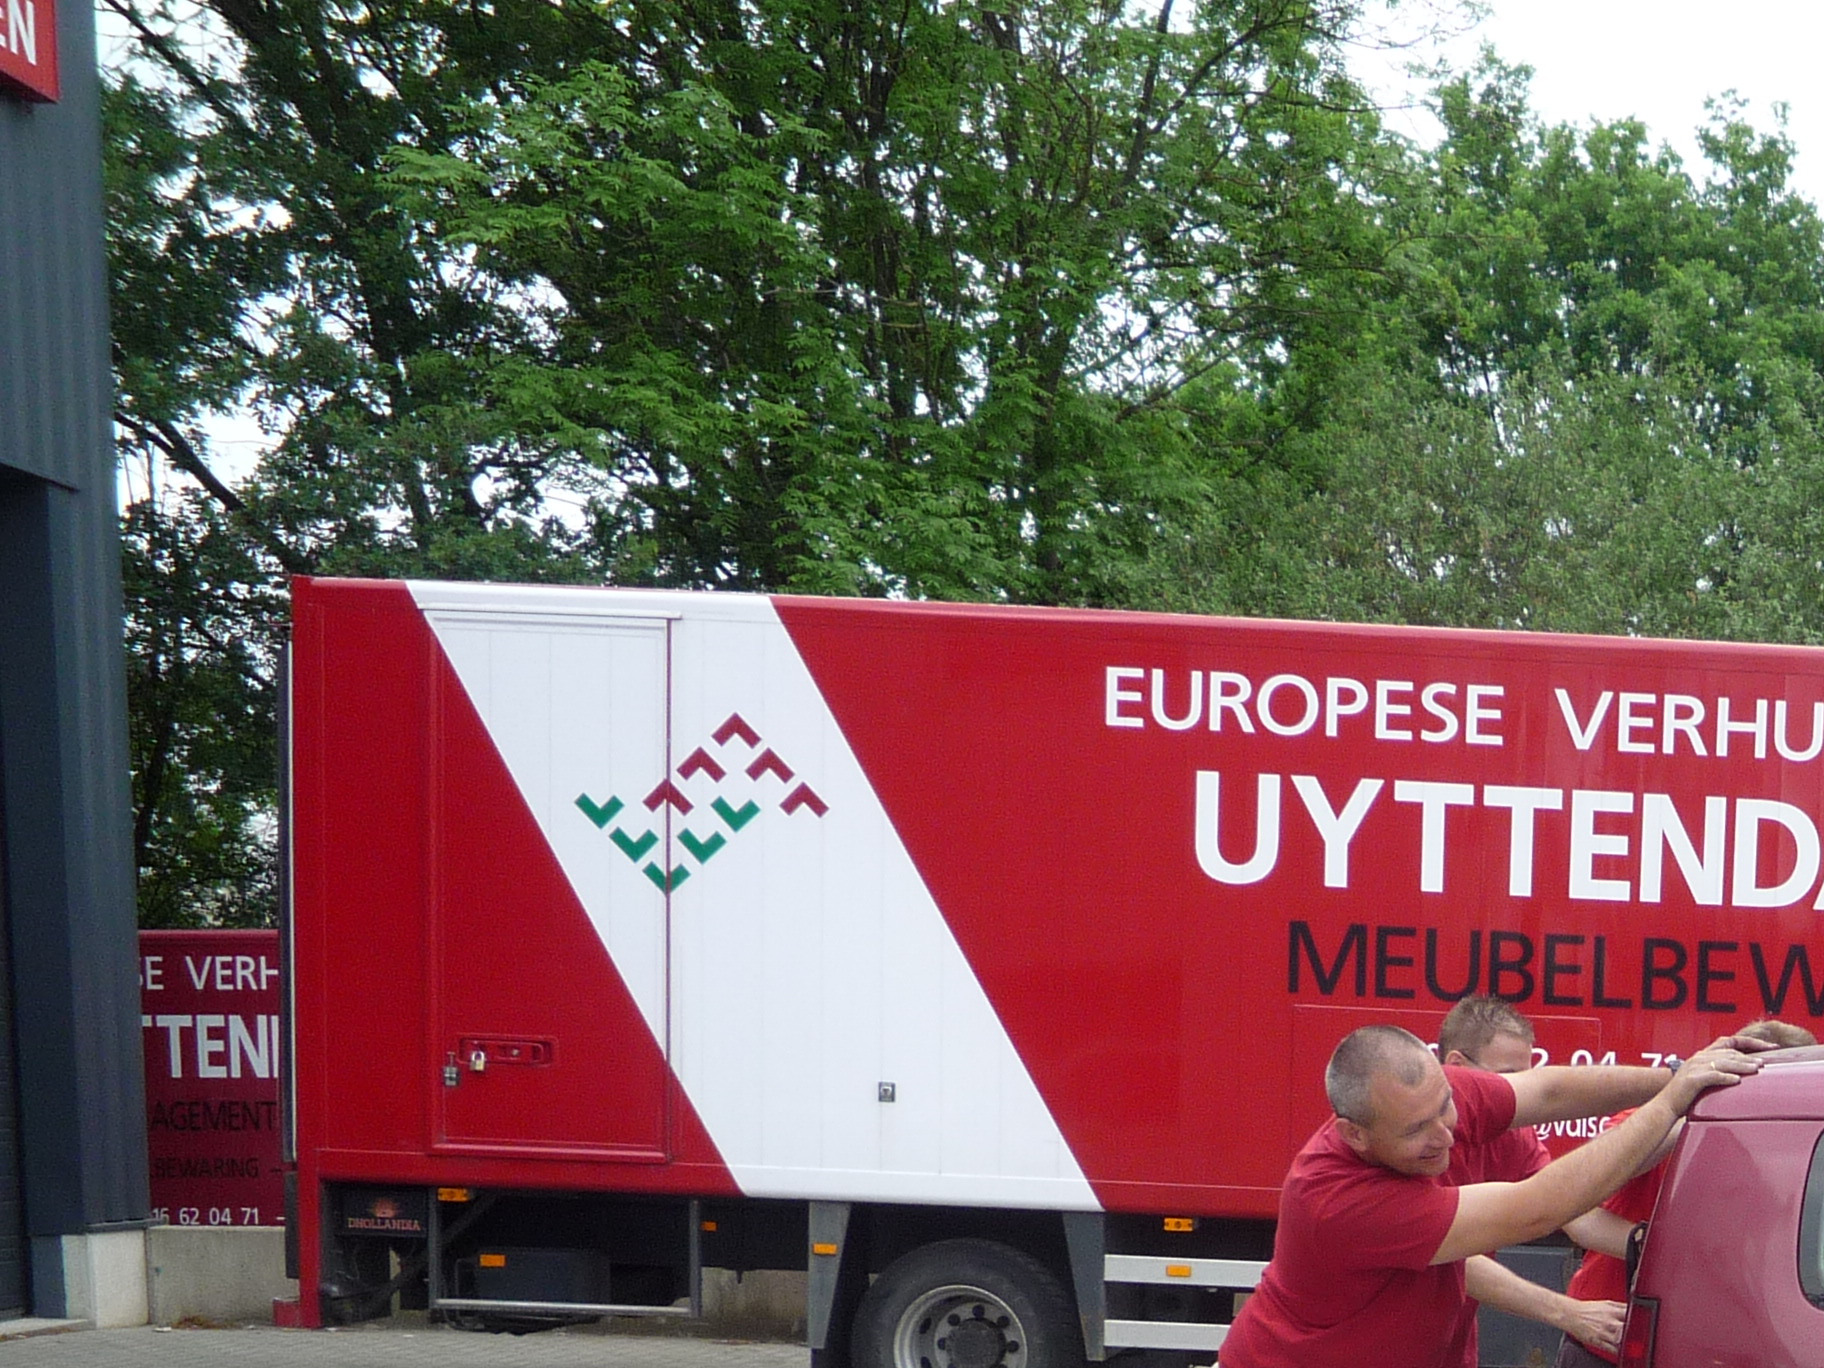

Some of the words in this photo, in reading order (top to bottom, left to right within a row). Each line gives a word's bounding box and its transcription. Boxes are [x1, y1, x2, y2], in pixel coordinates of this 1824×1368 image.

[1105, 666, 1504, 745] EUROPESE
[142, 1015, 279, 1078] TEN
[151, 1157, 259, 1178] BEWARING
[179, 1207, 199, 1224] 62
[209, 1207, 231, 1224] 04
[240, 1207, 259, 1224] 71
[348, 1217, 421, 1231] DHOLLANDIA
